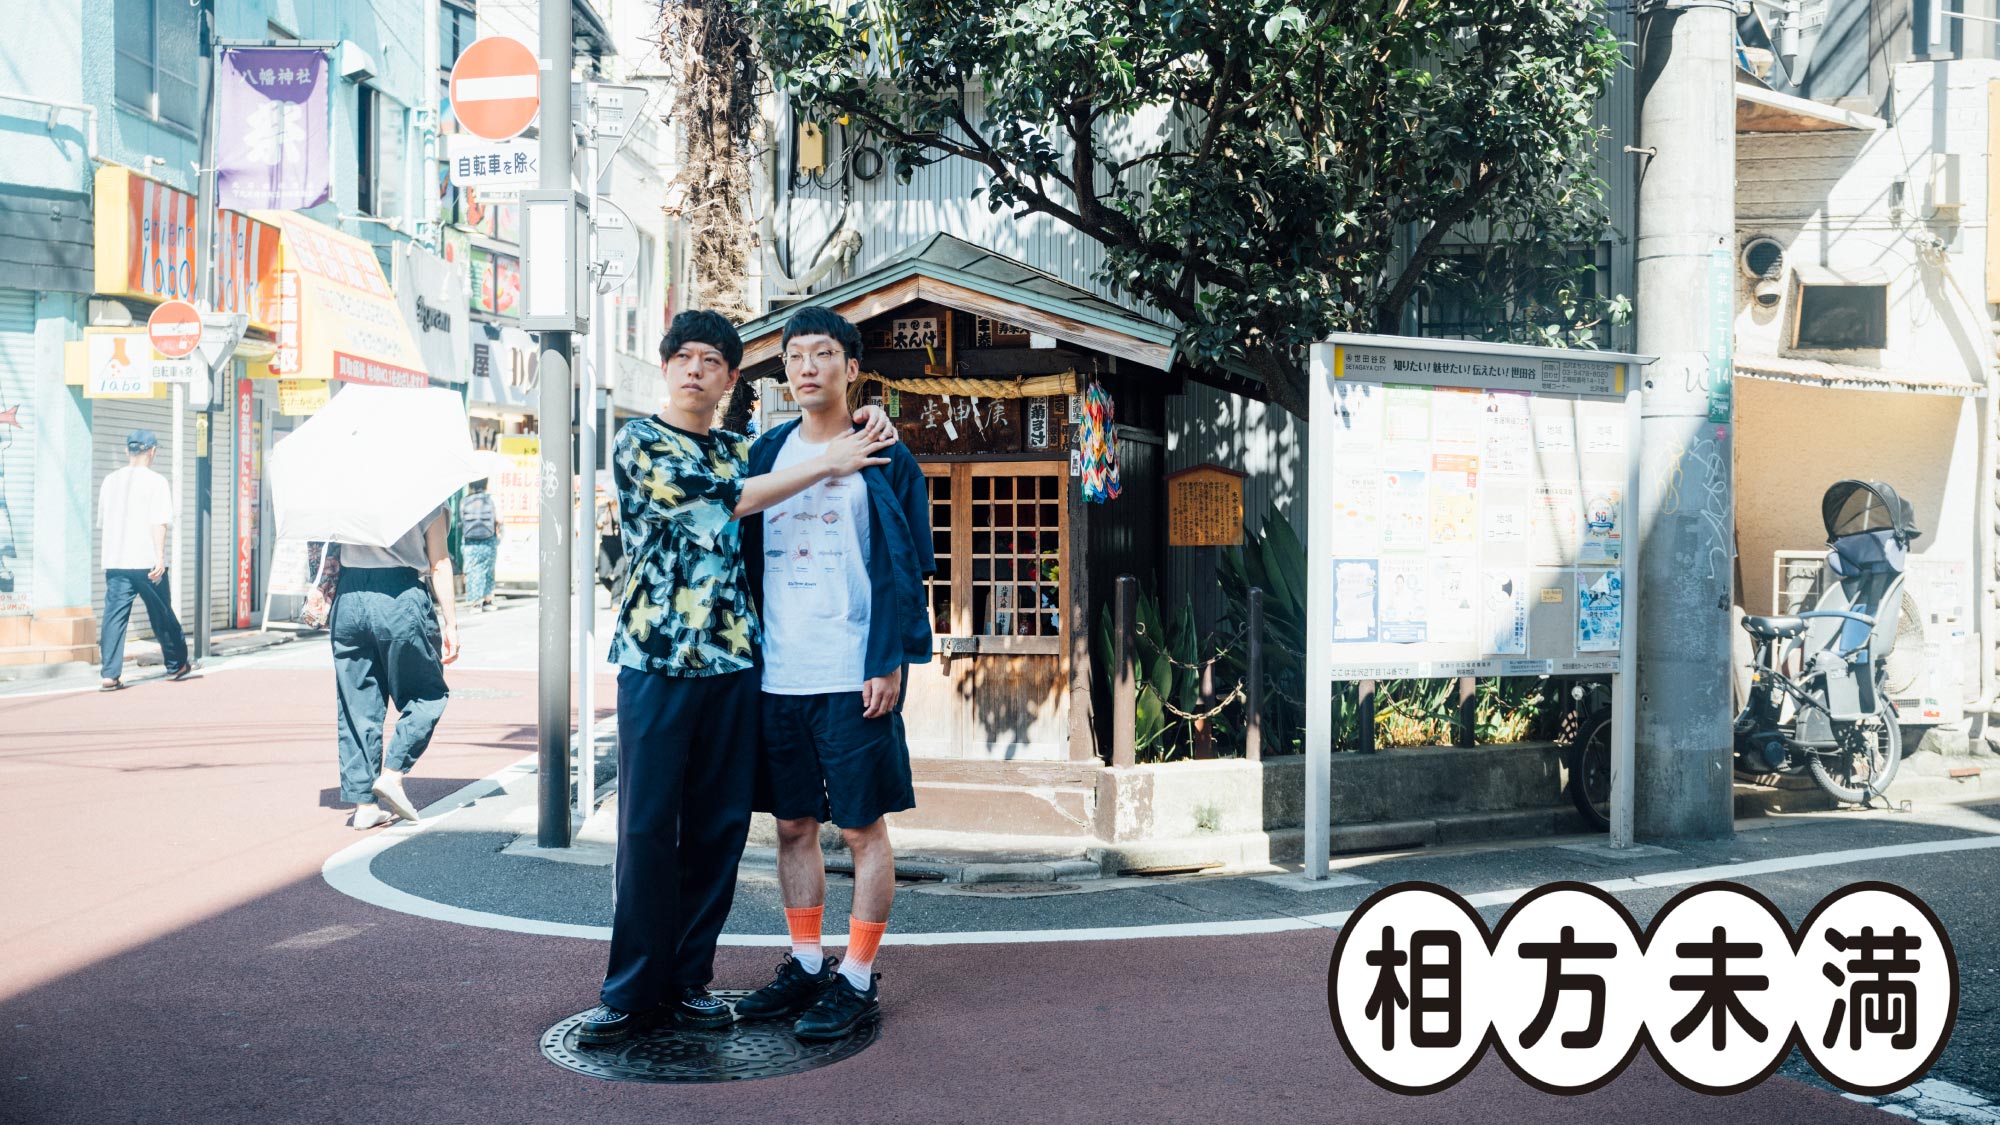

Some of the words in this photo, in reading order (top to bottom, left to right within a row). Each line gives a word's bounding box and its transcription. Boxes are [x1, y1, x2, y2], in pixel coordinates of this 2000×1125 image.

[239, 68, 312, 86] 八幡神社
[458, 151, 538, 177] 自転車を除く
[1354, 354, 1386, 364] 世田谷区
[1714, 366, 1729, 384] 14
[100, 380, 141, 392] labo
